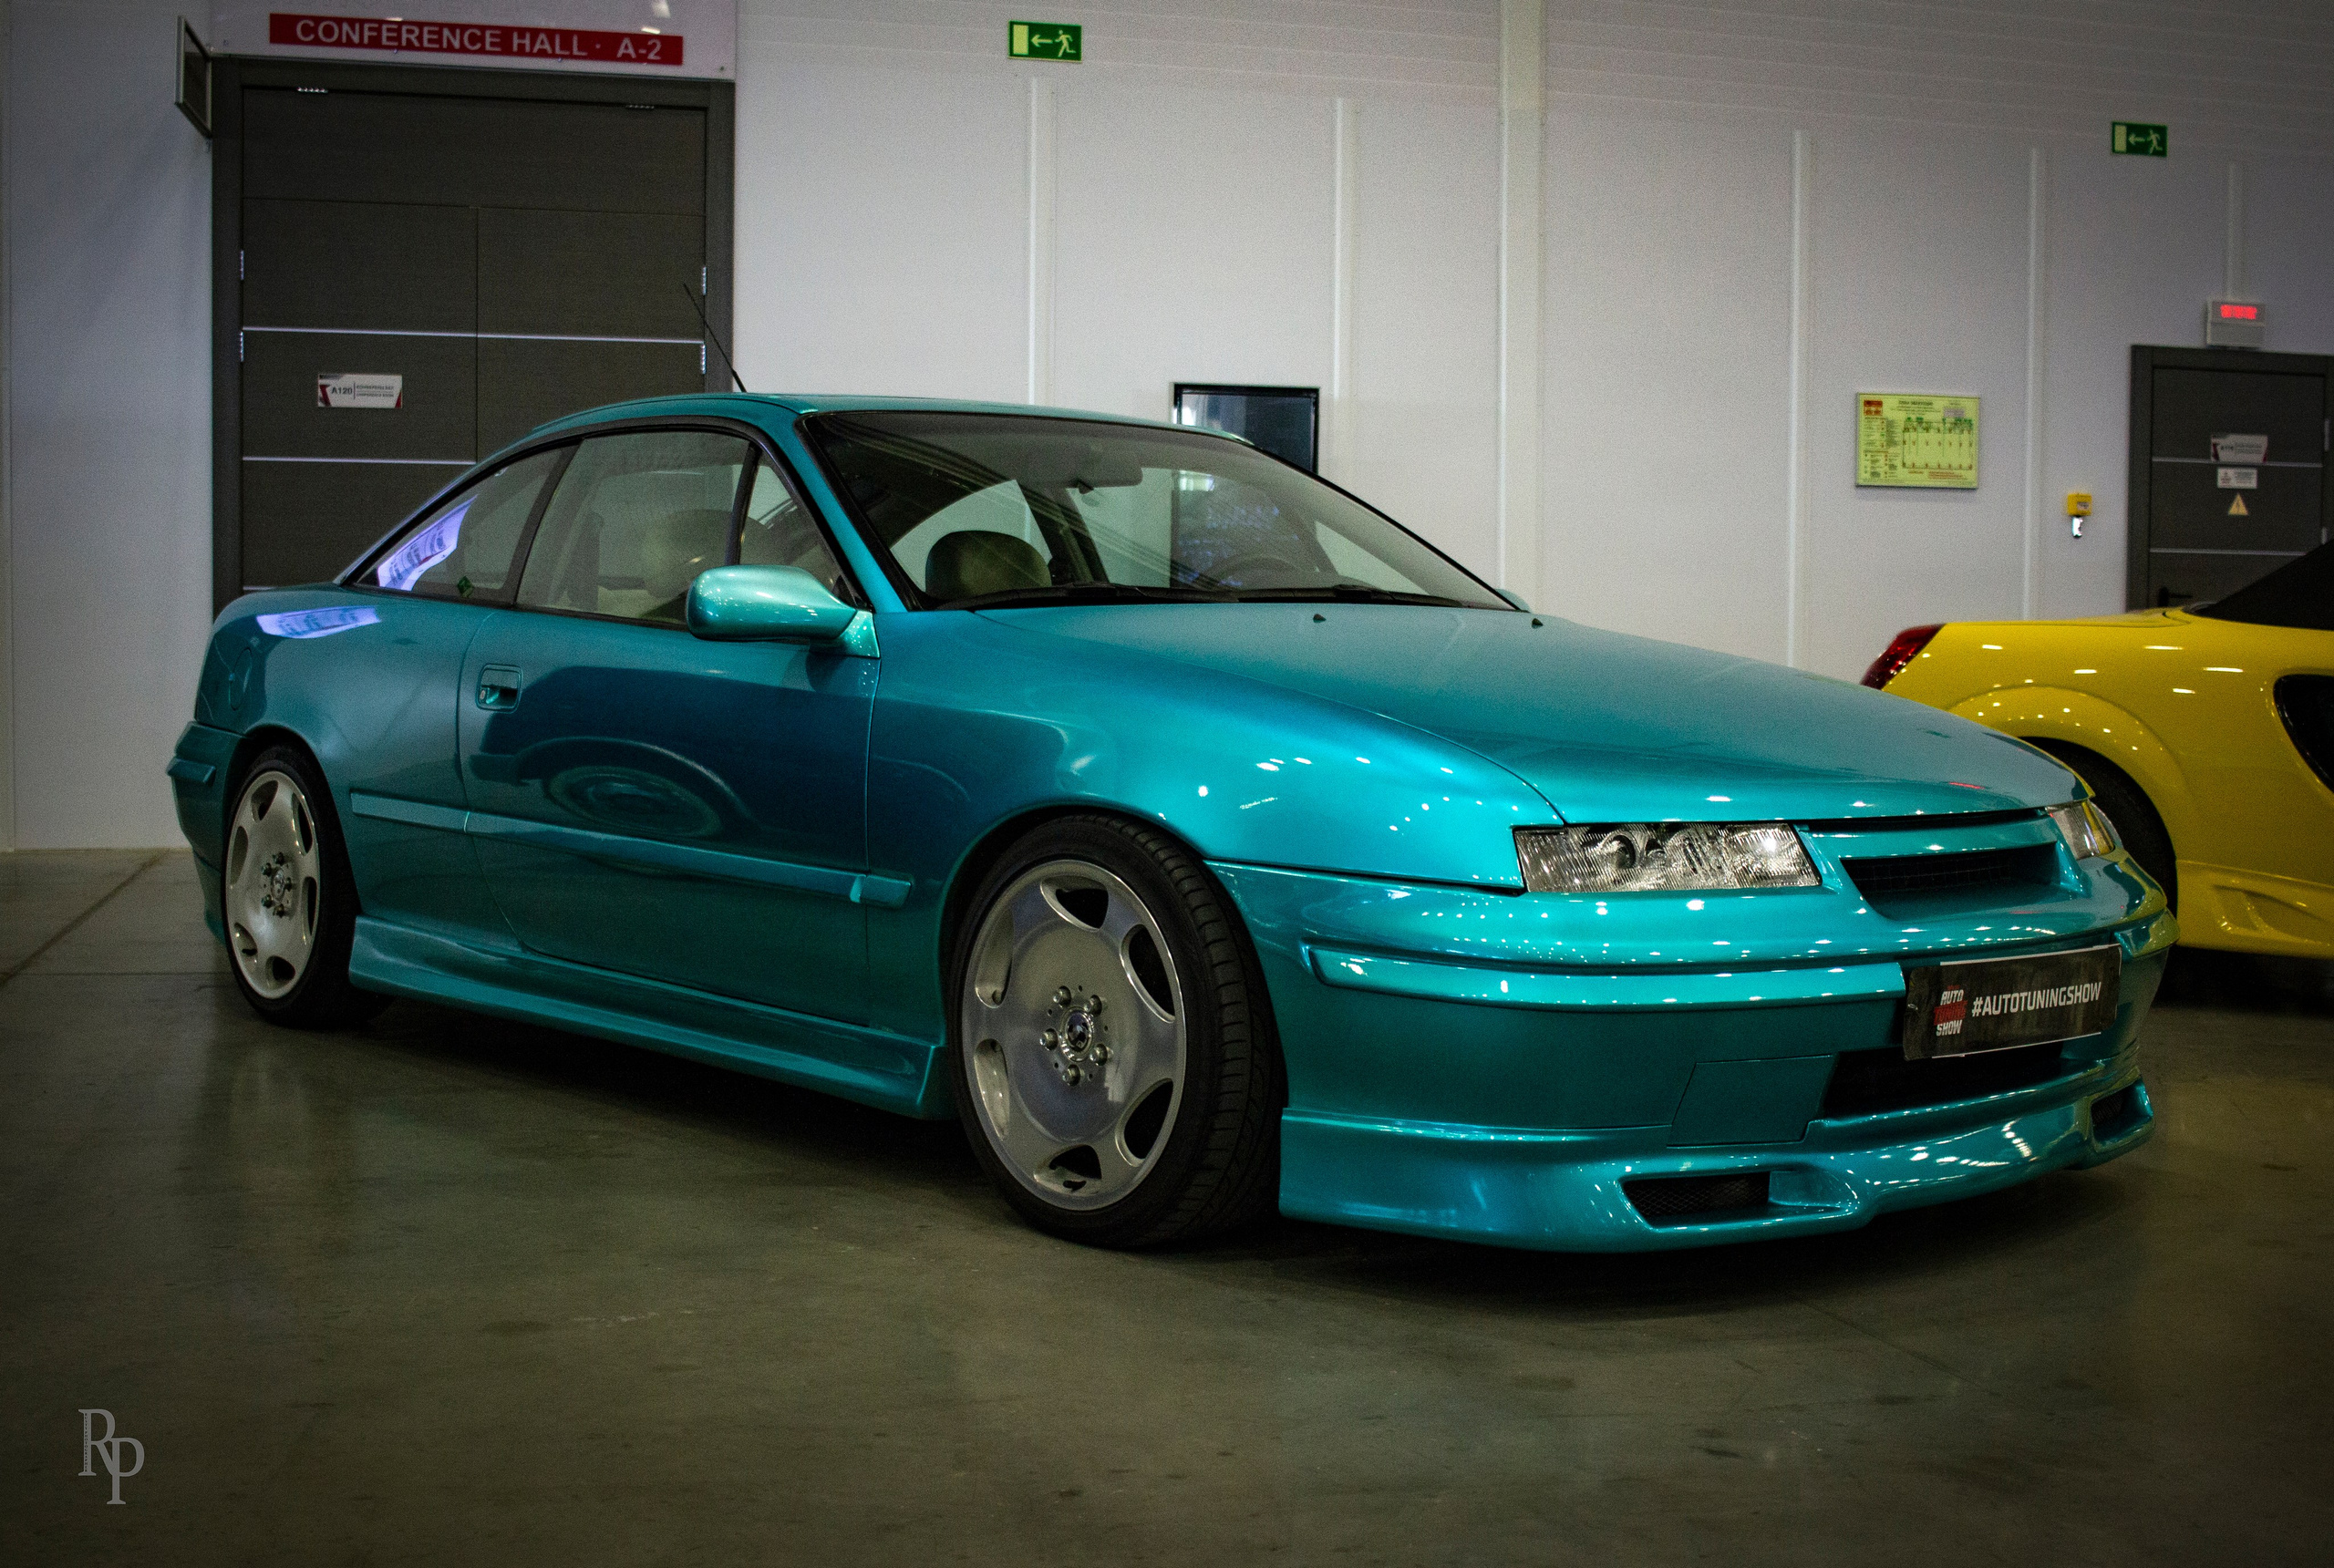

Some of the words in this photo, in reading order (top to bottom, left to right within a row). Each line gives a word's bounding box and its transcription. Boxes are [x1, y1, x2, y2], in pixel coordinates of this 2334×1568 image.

[296, 19, 501, 52] CONFERENCE
[512, 31, 588, 57] HALL
[616, 36, 662, 60] A-2
[331, 387, 353, 395] A120
[1940, 989, 1964, 1006] AUTO
[1972, 982, 2102, 1017] #AUTOTUNINGSHOW
[1936, 1019, 1963, 1037] SHOW
